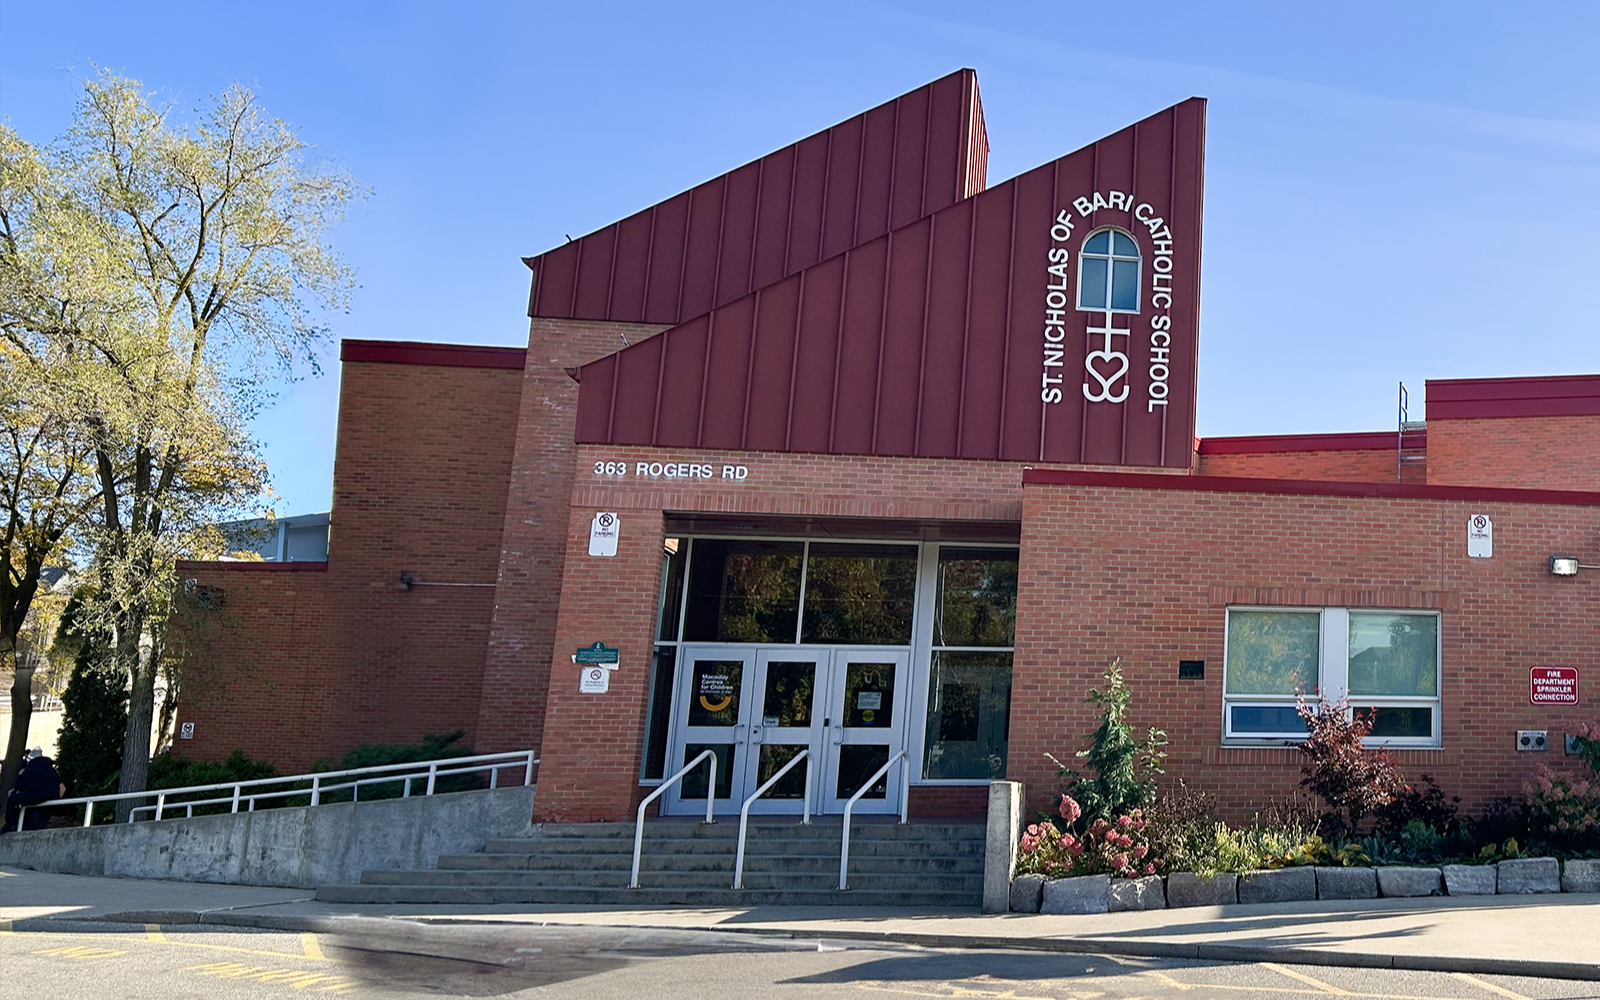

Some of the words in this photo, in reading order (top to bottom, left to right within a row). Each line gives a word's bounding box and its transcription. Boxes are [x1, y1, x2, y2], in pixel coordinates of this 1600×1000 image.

[1072, 190, 1134, 217] BARI
[1050, 209, 1075, 242] OF
[1134, 203, 1173, 309] CATHOLIC
[1043, 248, 1069, 367] NICHOLAS
[1148, 315, 1172, 413] SCHOOL
[1041, 373, 1063, 404] ST.
[593, 461, 627, 476] 363
[635, 462, 713, 478] ROGERS
[721, 465, 749, 480] RD
